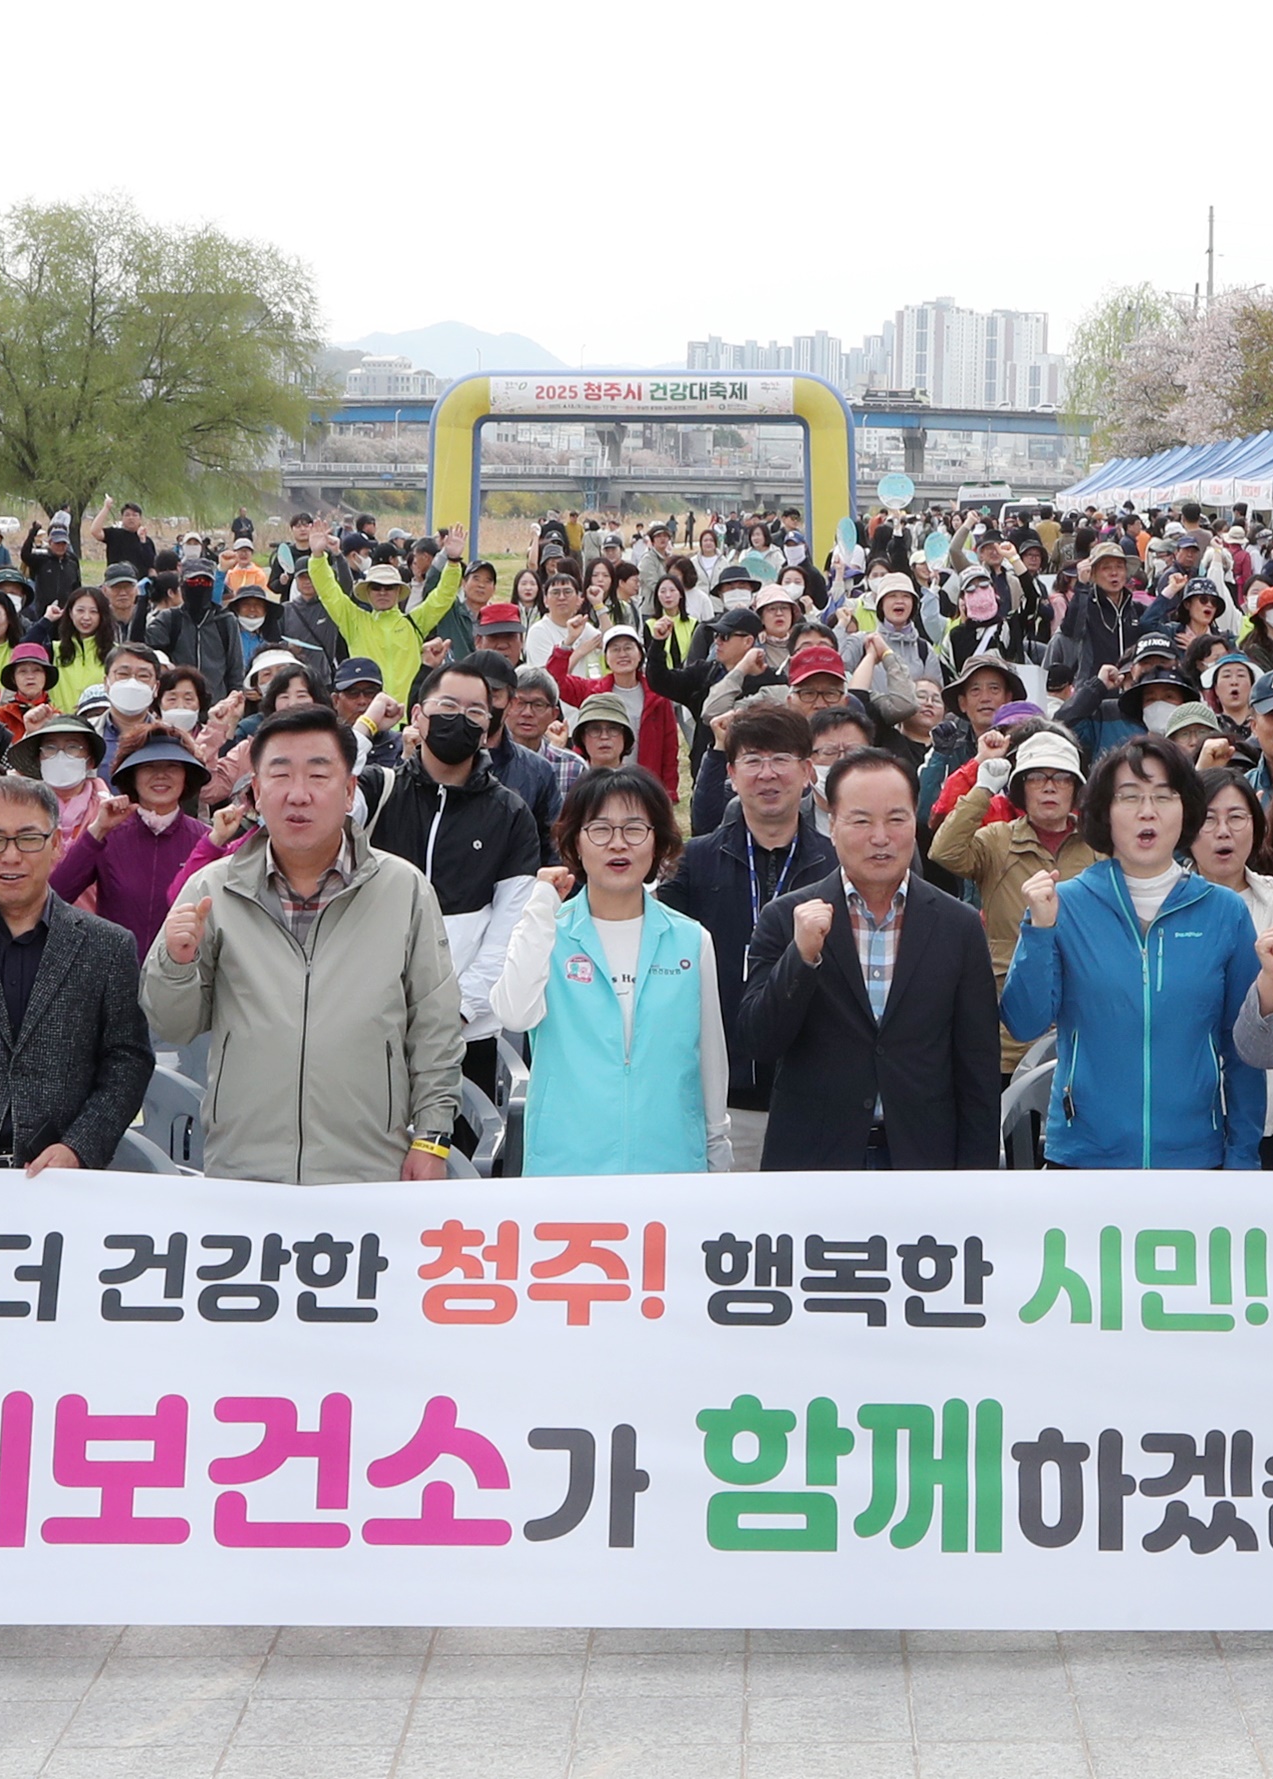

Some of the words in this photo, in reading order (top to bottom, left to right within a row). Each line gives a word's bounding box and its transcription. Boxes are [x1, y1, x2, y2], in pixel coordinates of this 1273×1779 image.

[535, 386, 578, 400] 2025
[584, 382, 642, 401] 청주시
[650, 381, 748, 402] 건강대축제
[98, 1231, 389, 1323] 건강한
[418, 1222, 666, 1325] 청주!
[702, 1232, 993, 1328] 행복한
[1019, 1226, 1268, 1333] 시민!
